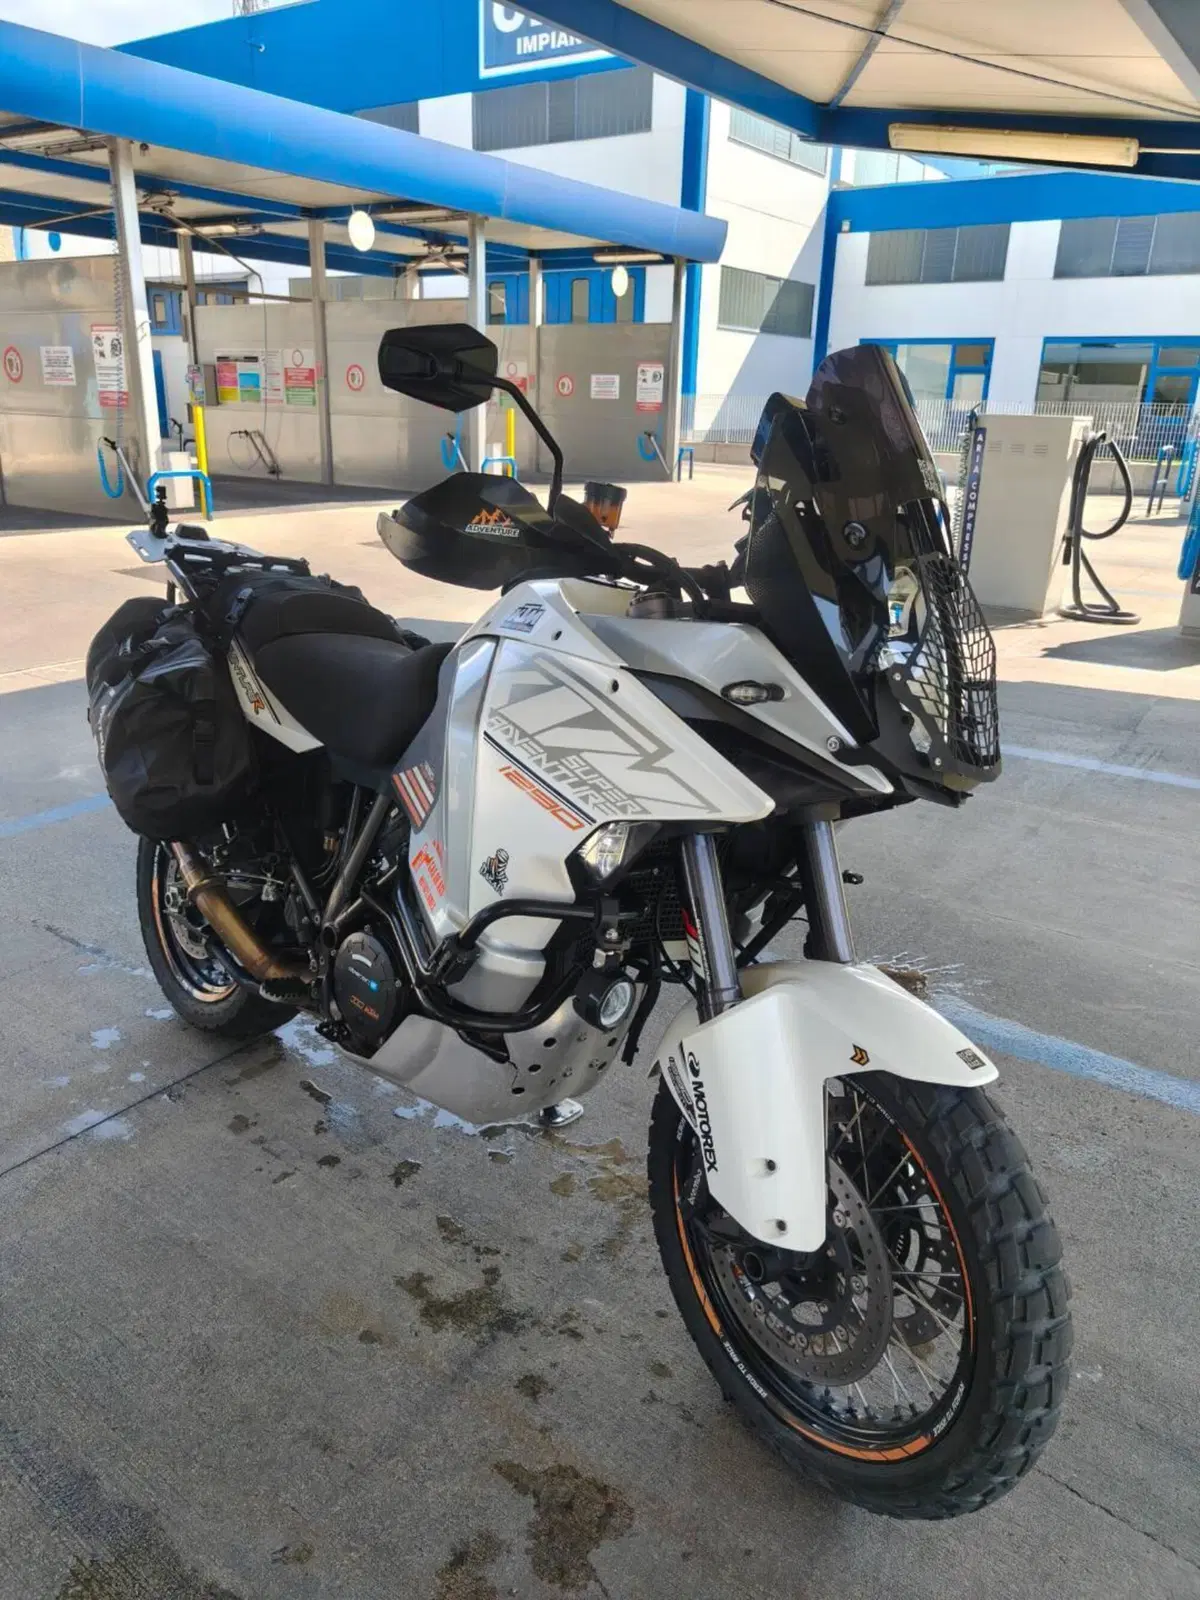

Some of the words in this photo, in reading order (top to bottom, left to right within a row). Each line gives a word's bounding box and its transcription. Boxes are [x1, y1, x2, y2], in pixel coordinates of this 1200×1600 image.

[973, 433, 985, 473] ARIA
[465, 524, 519, 537] ADVENTURE
[961, 481, 978, 571] COMPRESSA
[488, 716, 621, 818] ADVENTURE
[498, 765, 585, 831] 1290
[561, 754, 643, 814] SUPER
[692, 1081, 718, 1173] MOTOREX
